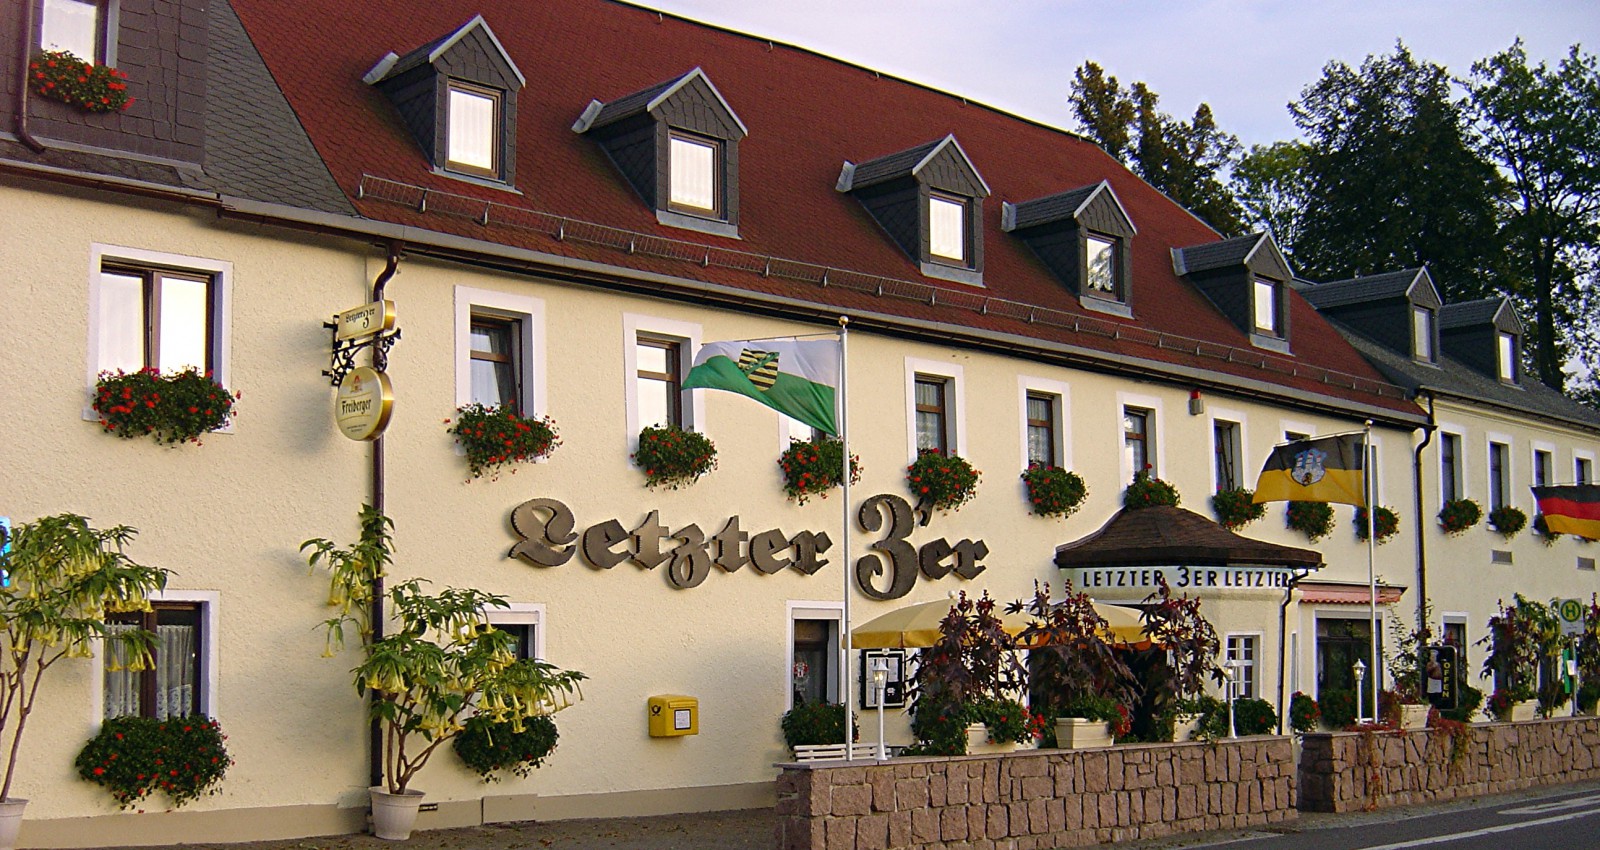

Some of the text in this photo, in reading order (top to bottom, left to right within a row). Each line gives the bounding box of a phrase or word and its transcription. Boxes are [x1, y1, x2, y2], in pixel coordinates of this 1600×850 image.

[341, 399, 371, 415] Freiberger
[508, 498, 833, 590] Letzter
[1083, 565, 1290, 588] LETZTER 3ER LETZTER
[1565, 605, 1576, 617] H
[1442, 662, 1451, 698] OFFEN
